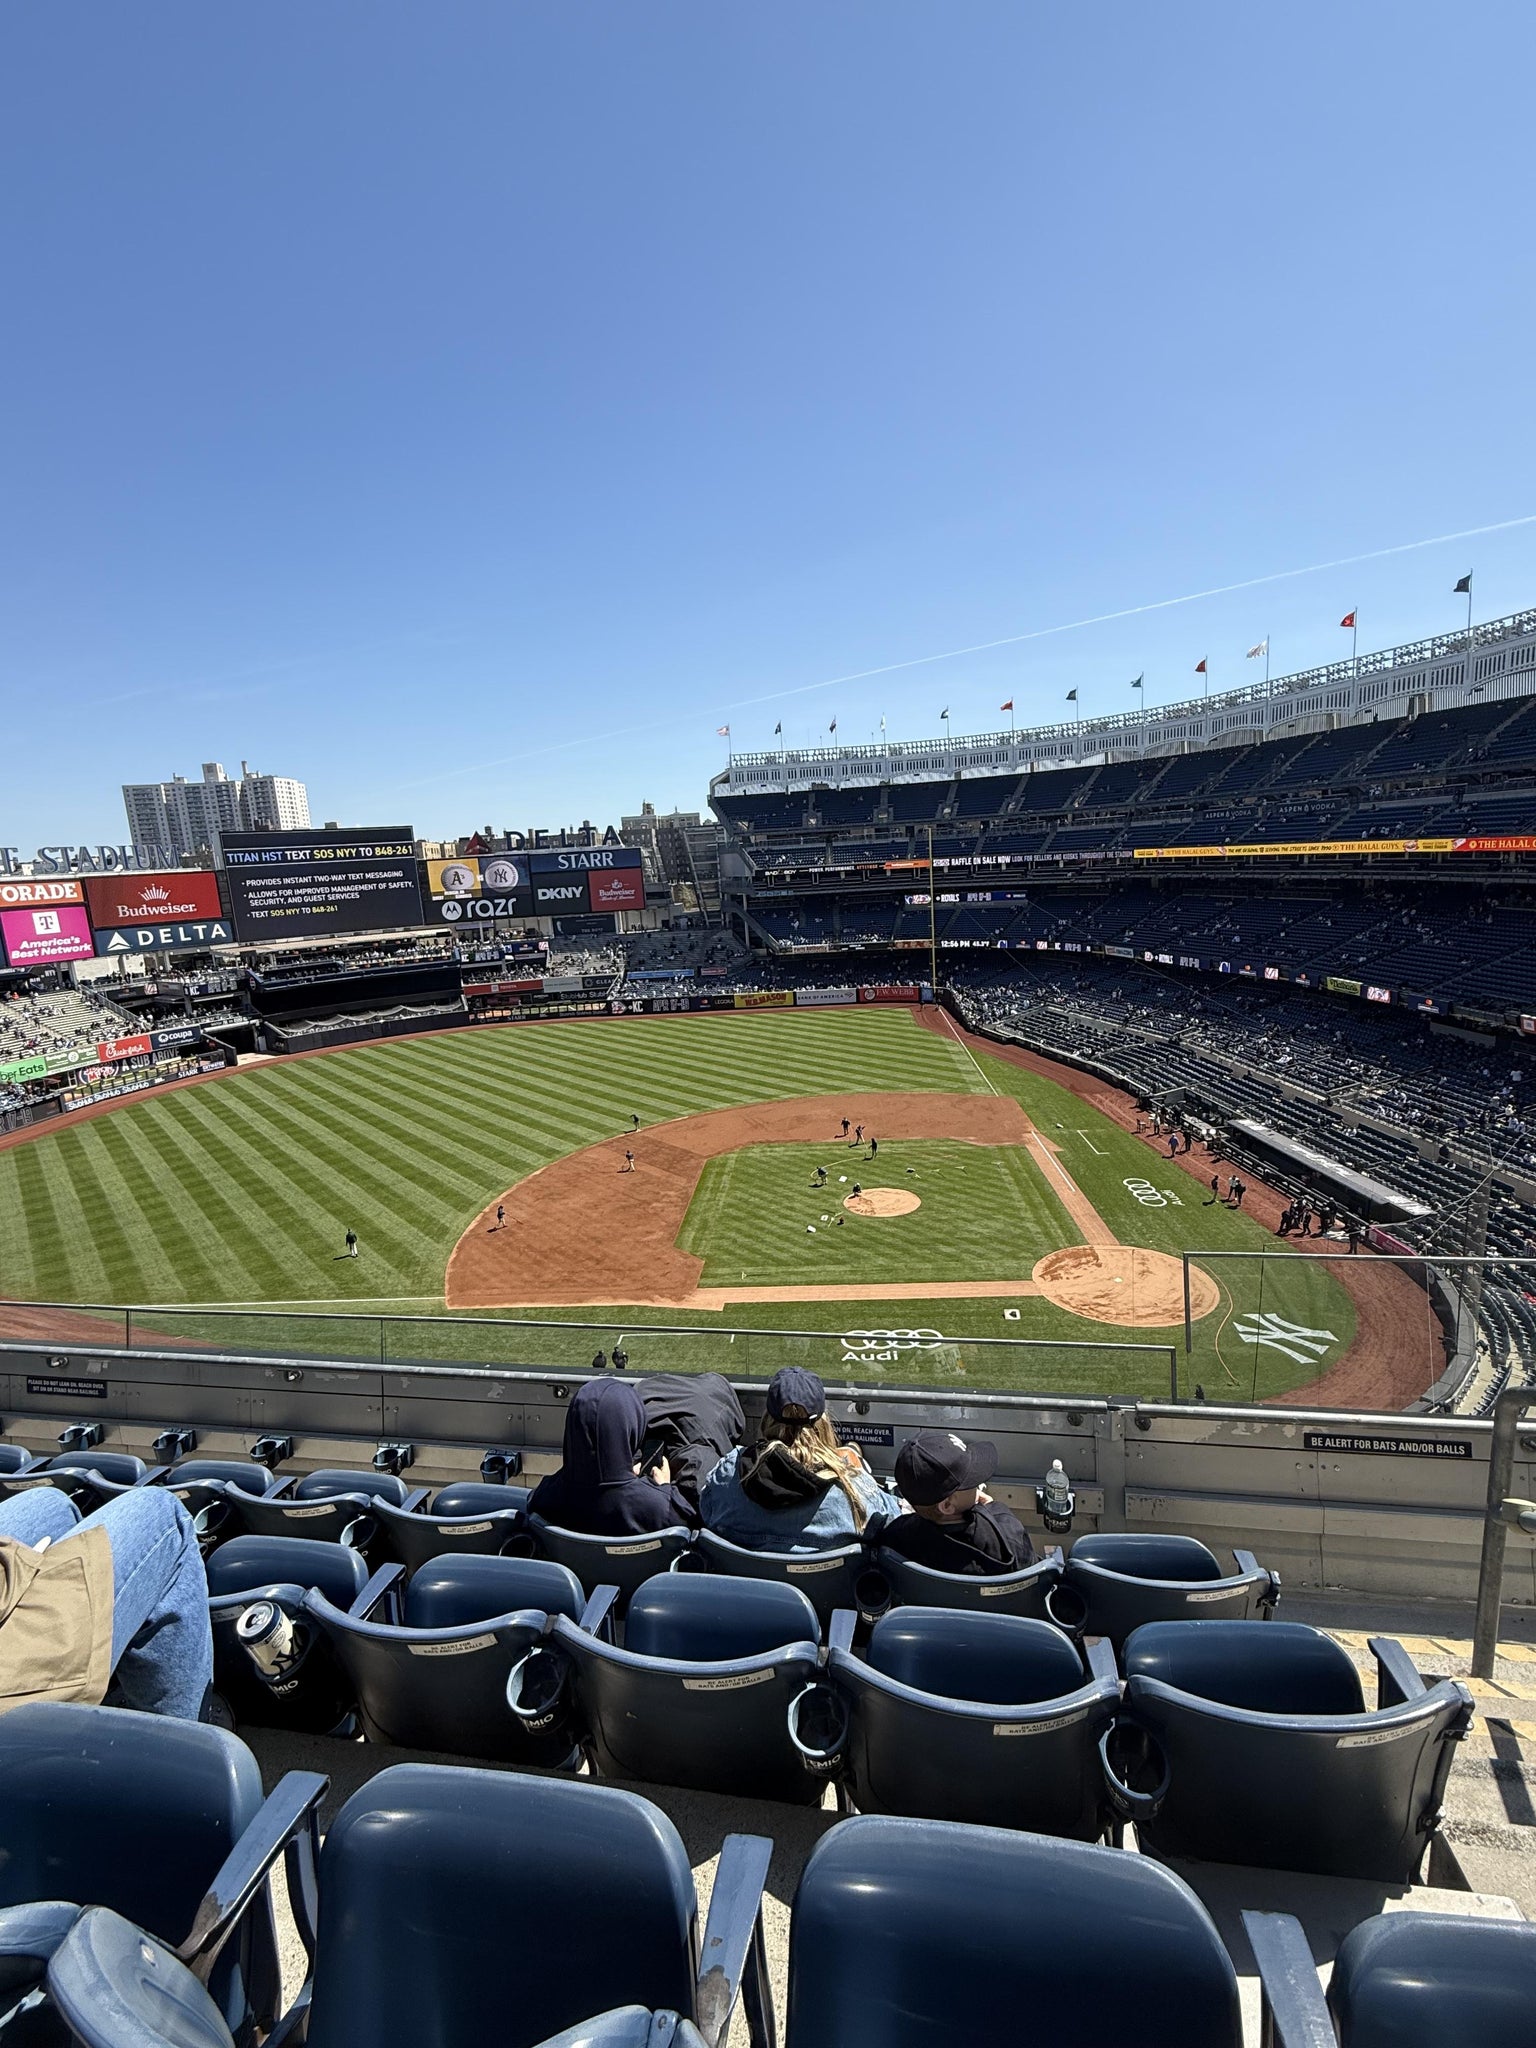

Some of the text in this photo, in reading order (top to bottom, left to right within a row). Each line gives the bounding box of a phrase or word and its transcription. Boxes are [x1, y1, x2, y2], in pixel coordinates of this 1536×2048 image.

[505, 825, 625, 851] DELTA
[38, 843, 182, 873] STADIUM
[227, 845, 412, 863] TITAN HST TEXT SOS NYY TO 848-261
[558, 852, 614, 869] STARR
[951, 858, 971, 866] RAFFLE
[246, 879, 282, 887] PROVIDES
[283, 876, 312, 884] INSTANT
[313, 874, 346, 883] TWO-WAY
[365, 870, 403, 879] MESSAGING
[248, 891, 278, 899] ALLOWS
[294, 887, 330, 895] IMPROVED
[331, 884, 377, 893] MANAGEMENT
[388, 881, 414, 889] SAFETY,
[537, 886, 583, 900] DKNY
[599, 888, 636, 897] Budweiser
[250, 898, 286, 907] SECURITY,
[327, 892, 360, 901] SERVICES
[466, 898, 516, 918] razr
[117, 903, 195, 918] Budweiser
[312, 905, 338, 913] 848-261
[20, 935, 81, 949] America's
[137, 923, 227, 946] DELTA
[11, 943, 91, 960] Best Network
[632, 1001, 643, 1012] KC
[169, 1030, 193, 1040] coupa
[122, 1047, 180, 1072] A SUB ABOVE
[19, 1063, 44, 1076] Eats
[68, 1068, 198, 1110] StubHub StubHub StubHub STARR
[841, 1351, 899, 1361] Audi
[1311, 1437, 1465, 1455] BE ALERT FOR BATS AND/OR BALLS
